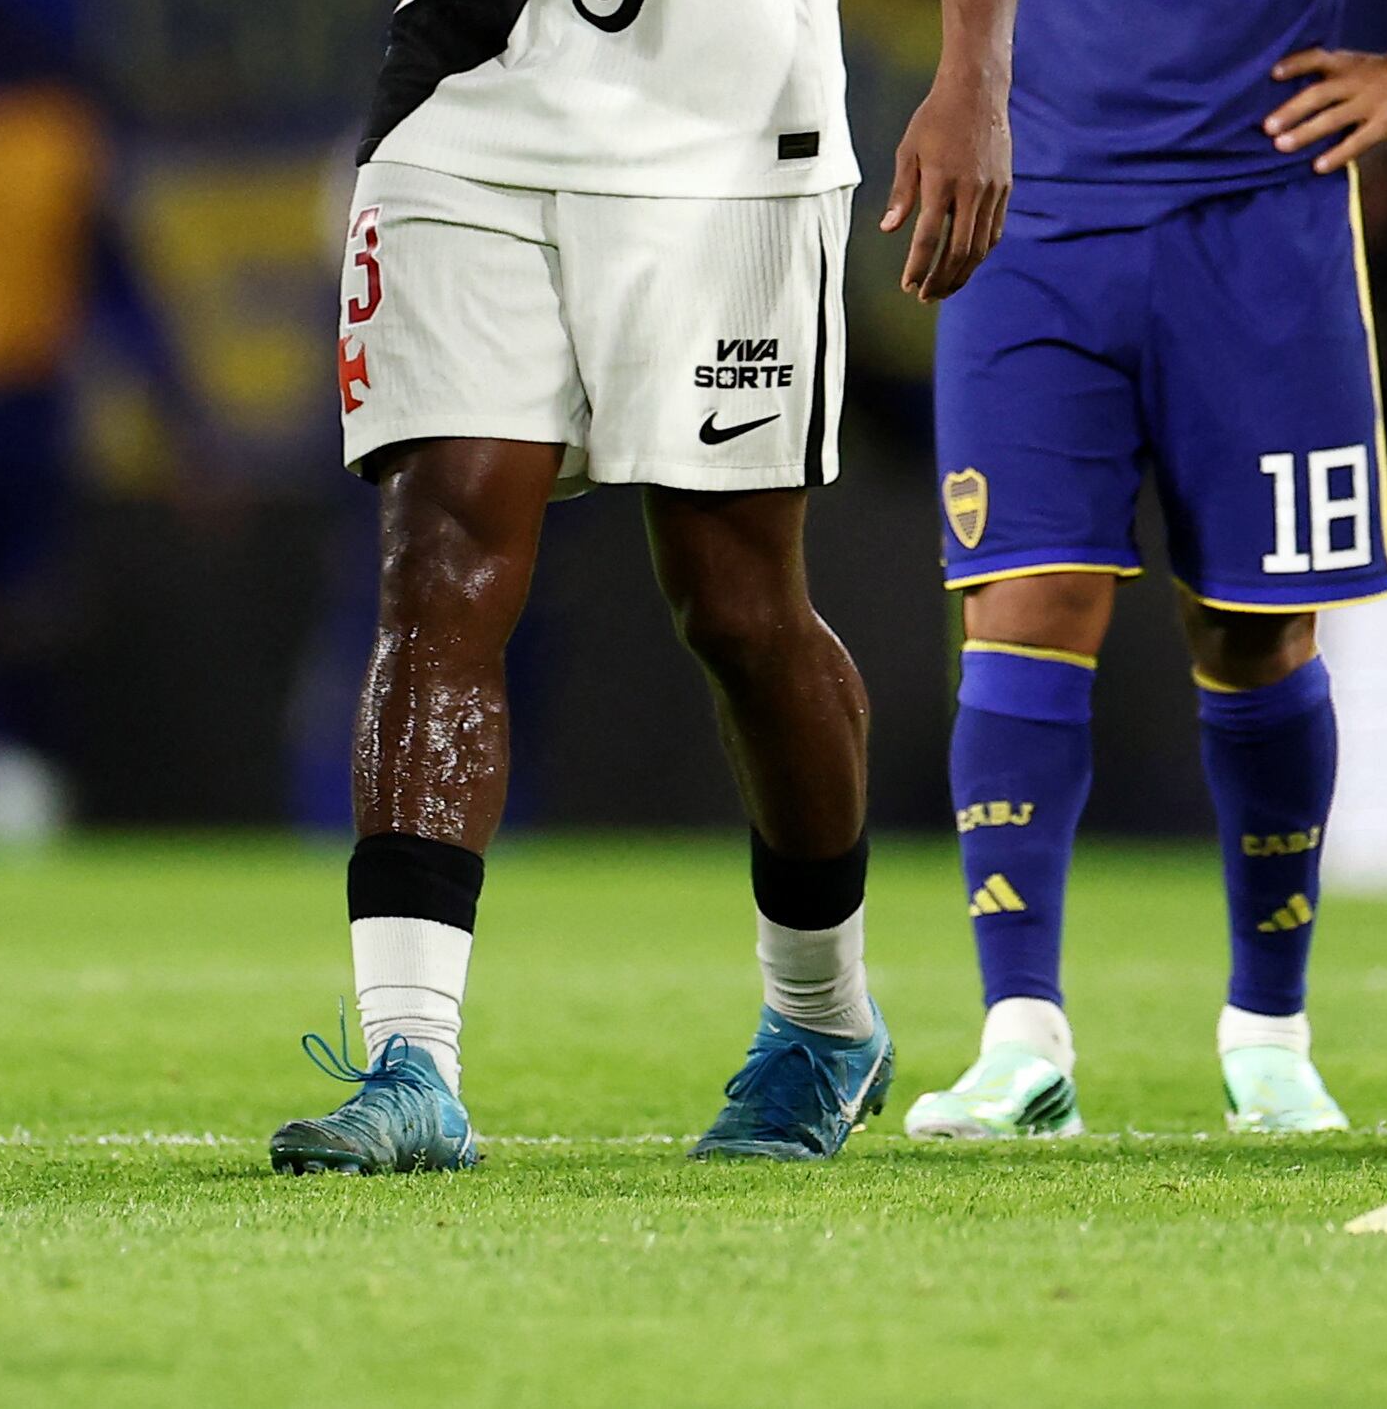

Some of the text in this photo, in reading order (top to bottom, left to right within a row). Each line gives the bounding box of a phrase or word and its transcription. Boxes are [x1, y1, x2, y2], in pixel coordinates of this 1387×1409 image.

[716, 338, 779, 362] VIVA
[694, 364, 794, 389] SORTE
[1259, 443, 1372, 574] 18
